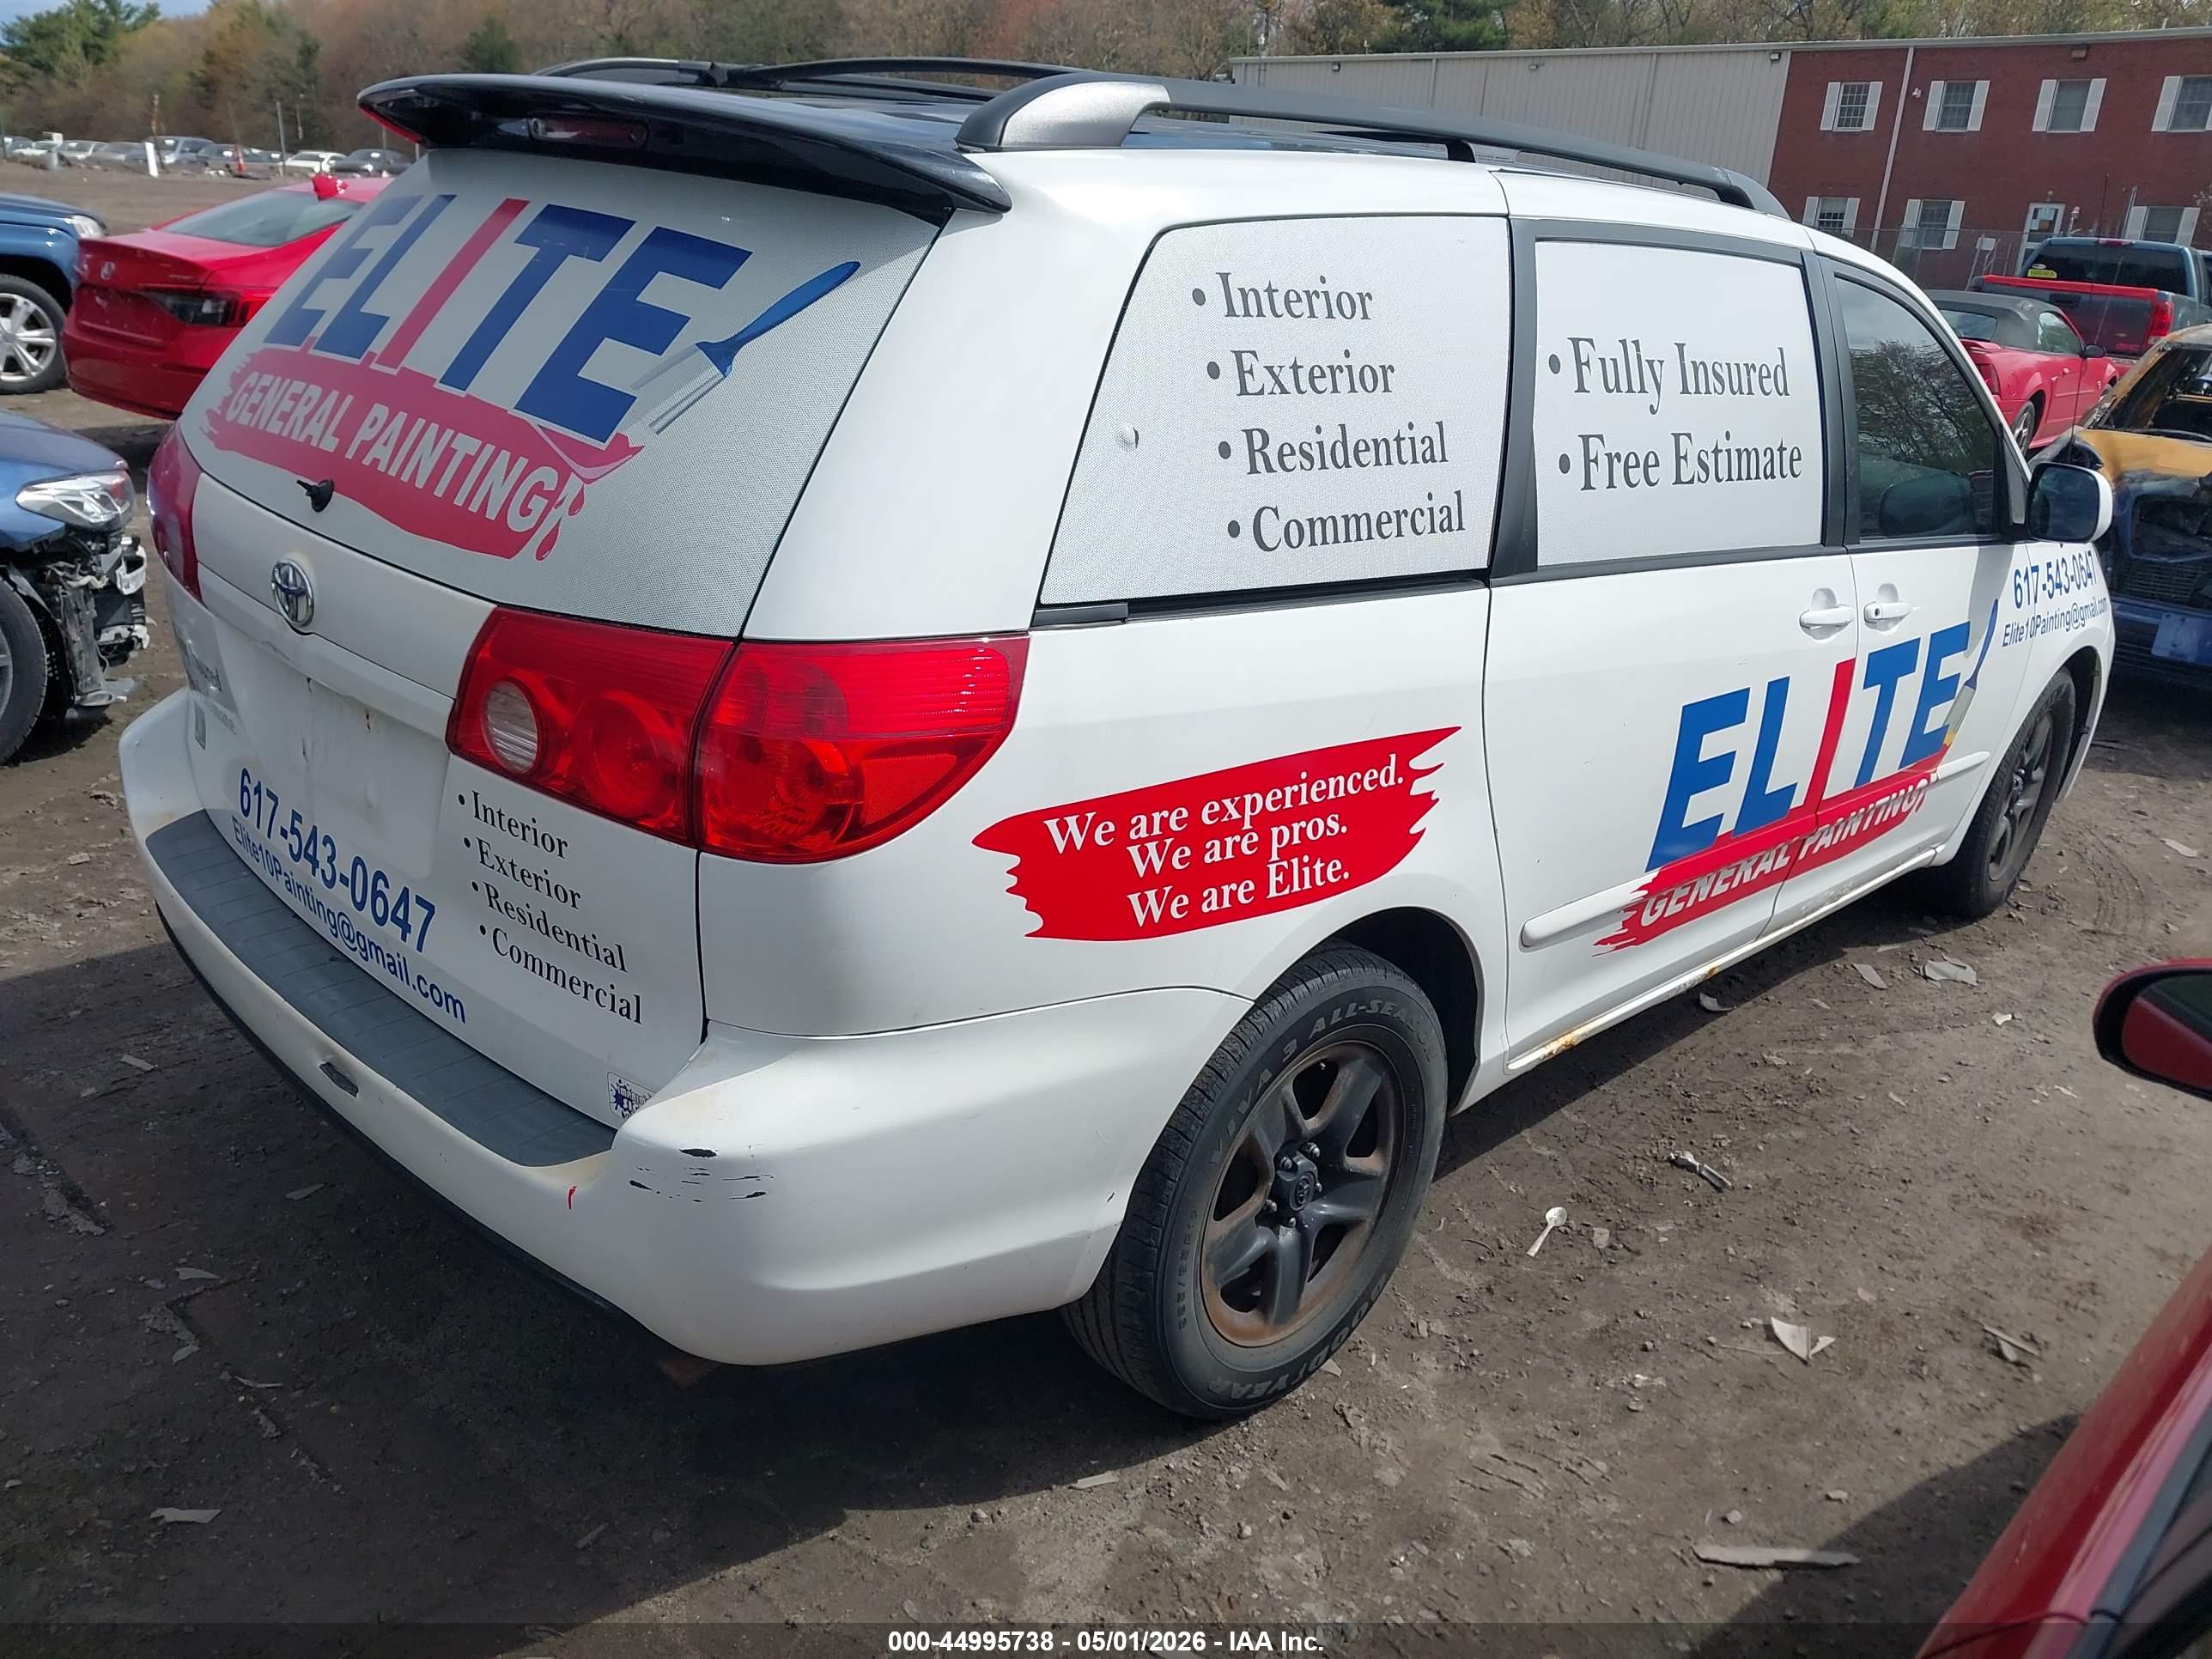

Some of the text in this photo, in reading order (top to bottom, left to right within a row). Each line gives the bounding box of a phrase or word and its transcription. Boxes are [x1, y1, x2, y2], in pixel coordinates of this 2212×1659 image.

[264, 194, 754, 444] ELITE
[1216, 273, 1373, 319] Interior
[1231, 349, 1395, 396] Exterior
[1568, 337, 1790, 416] Fully Insured
[226, 372, 559, 532] GENERAL PAINTING
[1242, 421, 1449, 475] Residential
[1578, 430, 1802, 490] Free Estimate
[1253, 490, 1466, 552] Commercial
[2014, 550, 2097, 609] 617-543-0647
[2002, 596, 2108, 647] Elite10Painting@gmail.com
[1645, 621, 1971, 872] ELITE
[471, 789, 568, 859] Interior
[1043, 754, 1404, 854] We are experienced.
[240, 768, 435, 953] 617-543-0647
[476, 837, 581, 910] Exterior
[1127, 813, 1347, 878] We are pros.
[1641, 776, 1929, 927] GENERAL PAINTING
[232, 815, 466, 1024] Elite10Painting@gmail.com
[483, 882, 629, 973] Residential
[1127, 855, 1349, 927] We are Elite.
[492, 928, 642, 1024] Commercial
